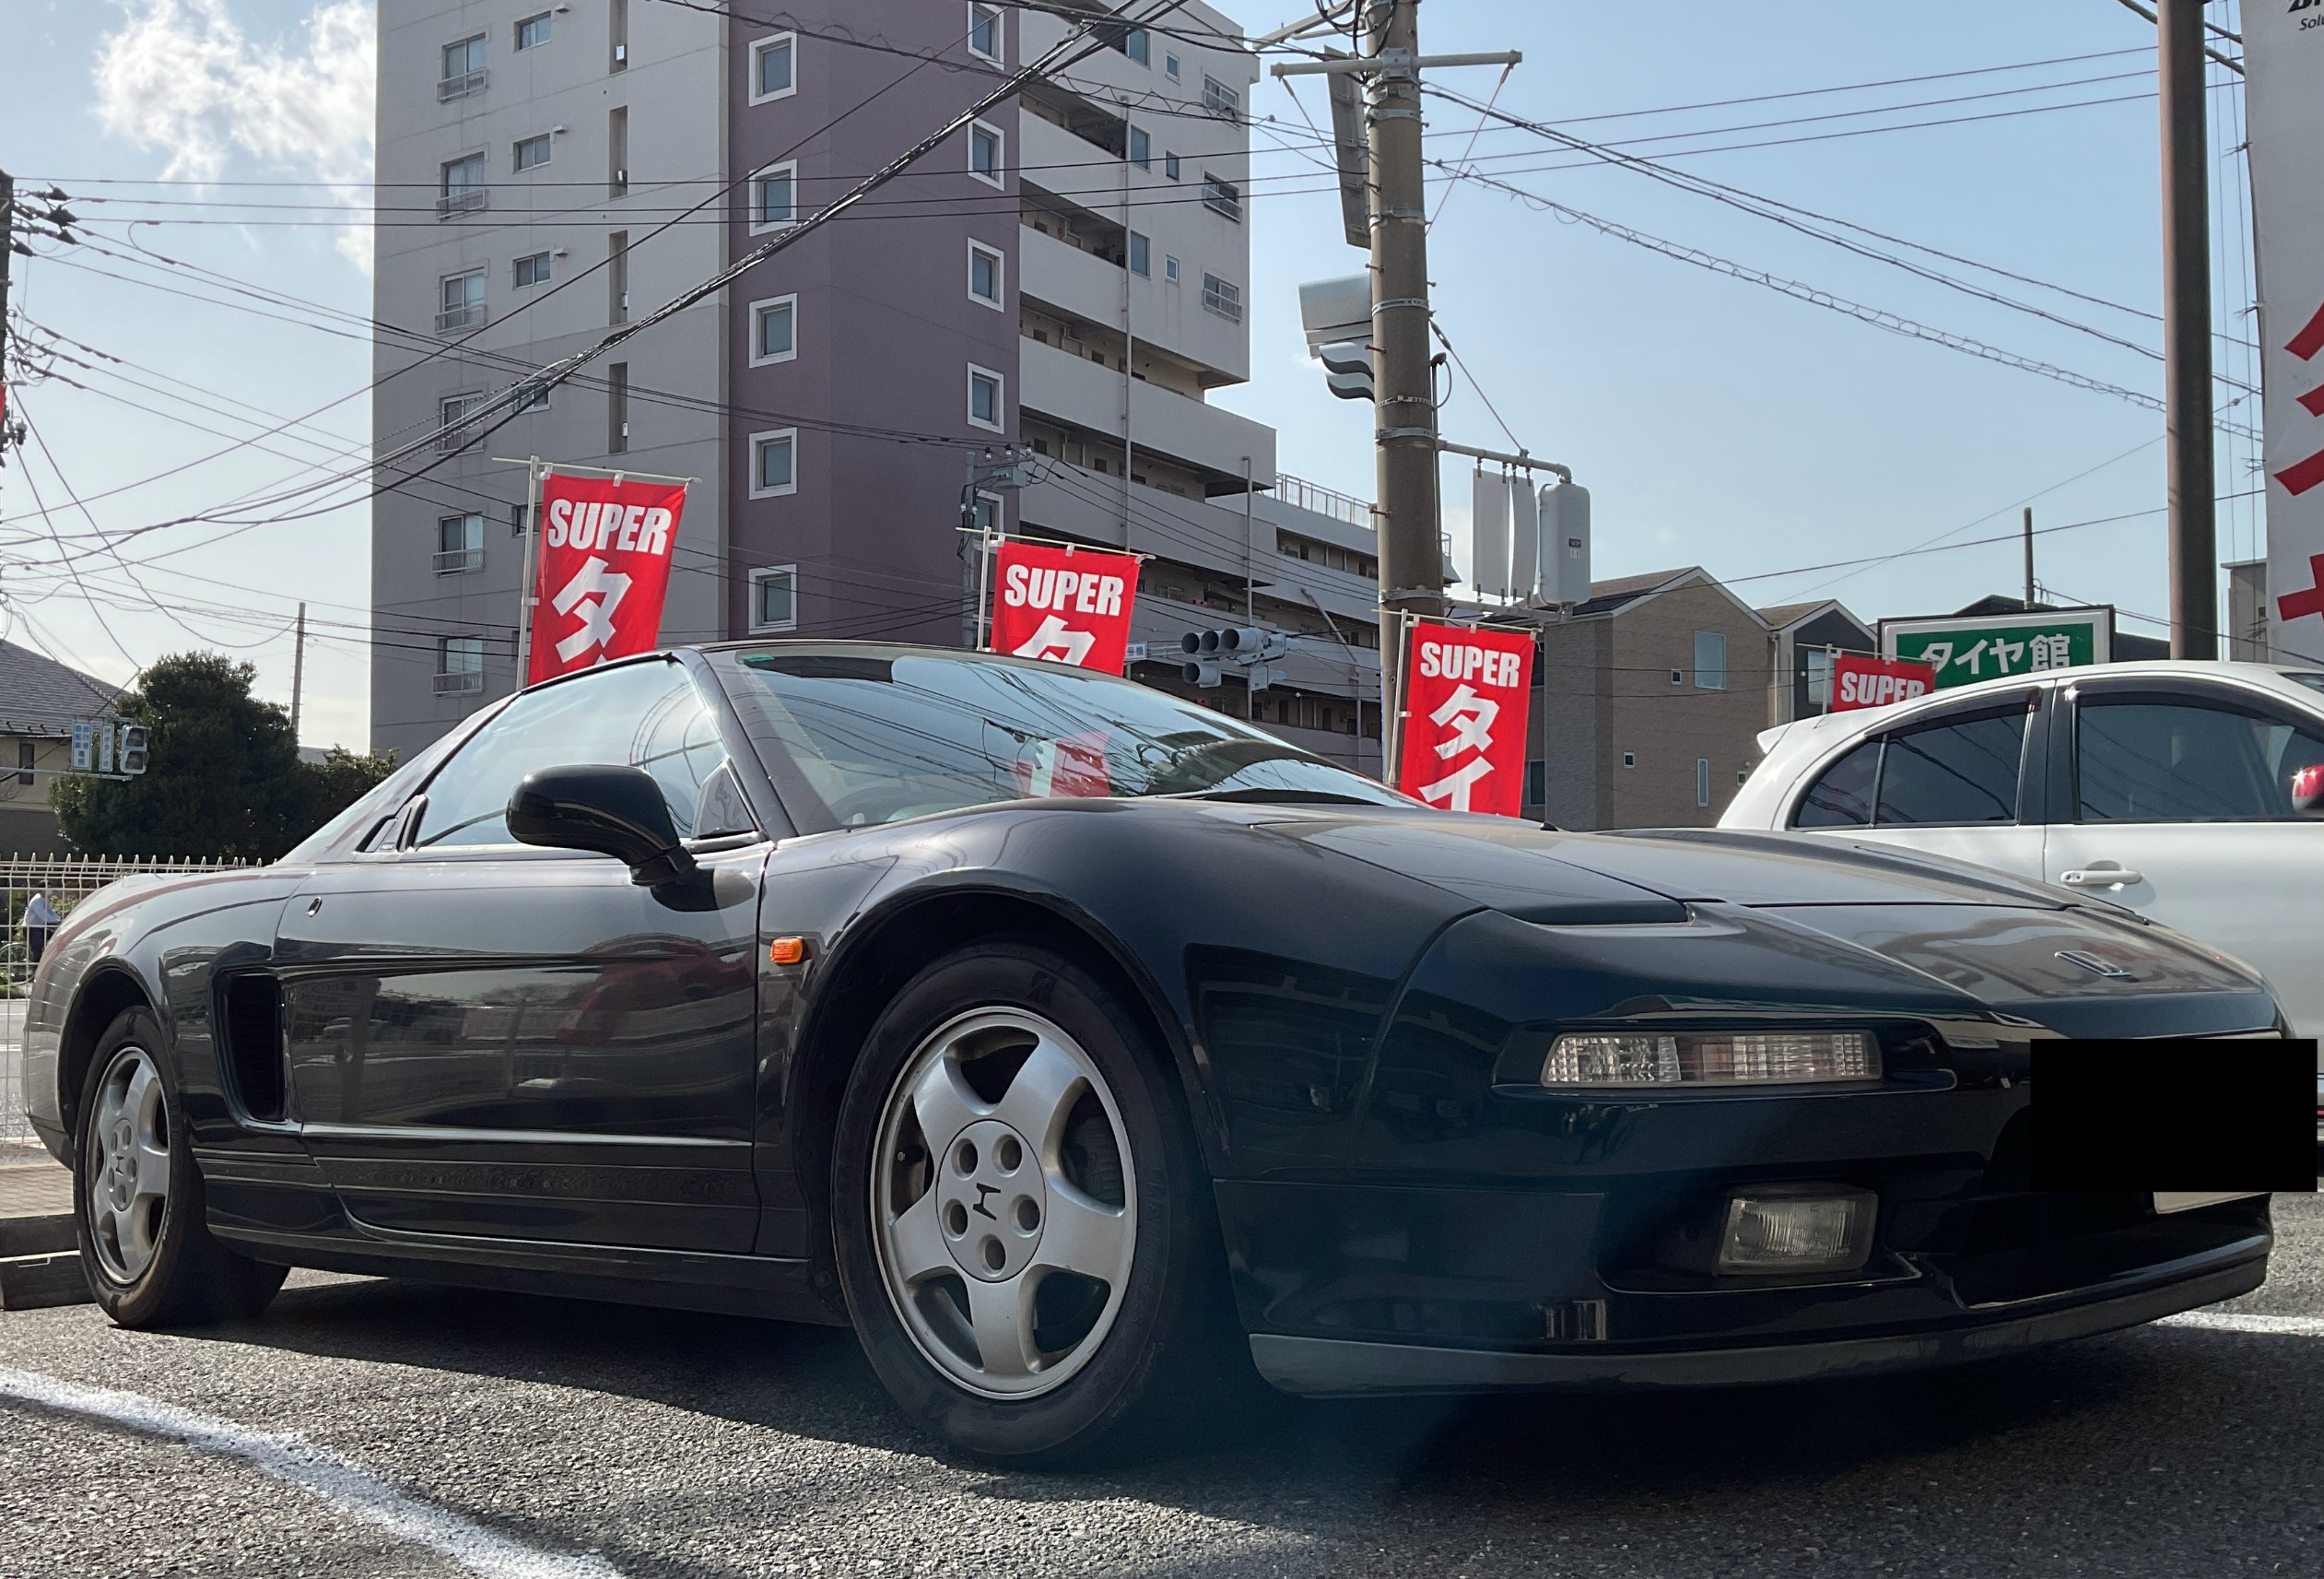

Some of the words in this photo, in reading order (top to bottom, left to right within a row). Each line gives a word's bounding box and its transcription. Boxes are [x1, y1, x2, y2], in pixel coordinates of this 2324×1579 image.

[2298, 14, 2324, 30] Sol
[547, 499, 673, 556] SUPER
[551, 555, 633, 666] タ
[1004, 564, 1124, 617] SUPER
[1420, 642, 1520, 688] SUPER
[1919, 633, 2072, 675] タイヤ館
[1417, 683, 1501, 812] タイ
